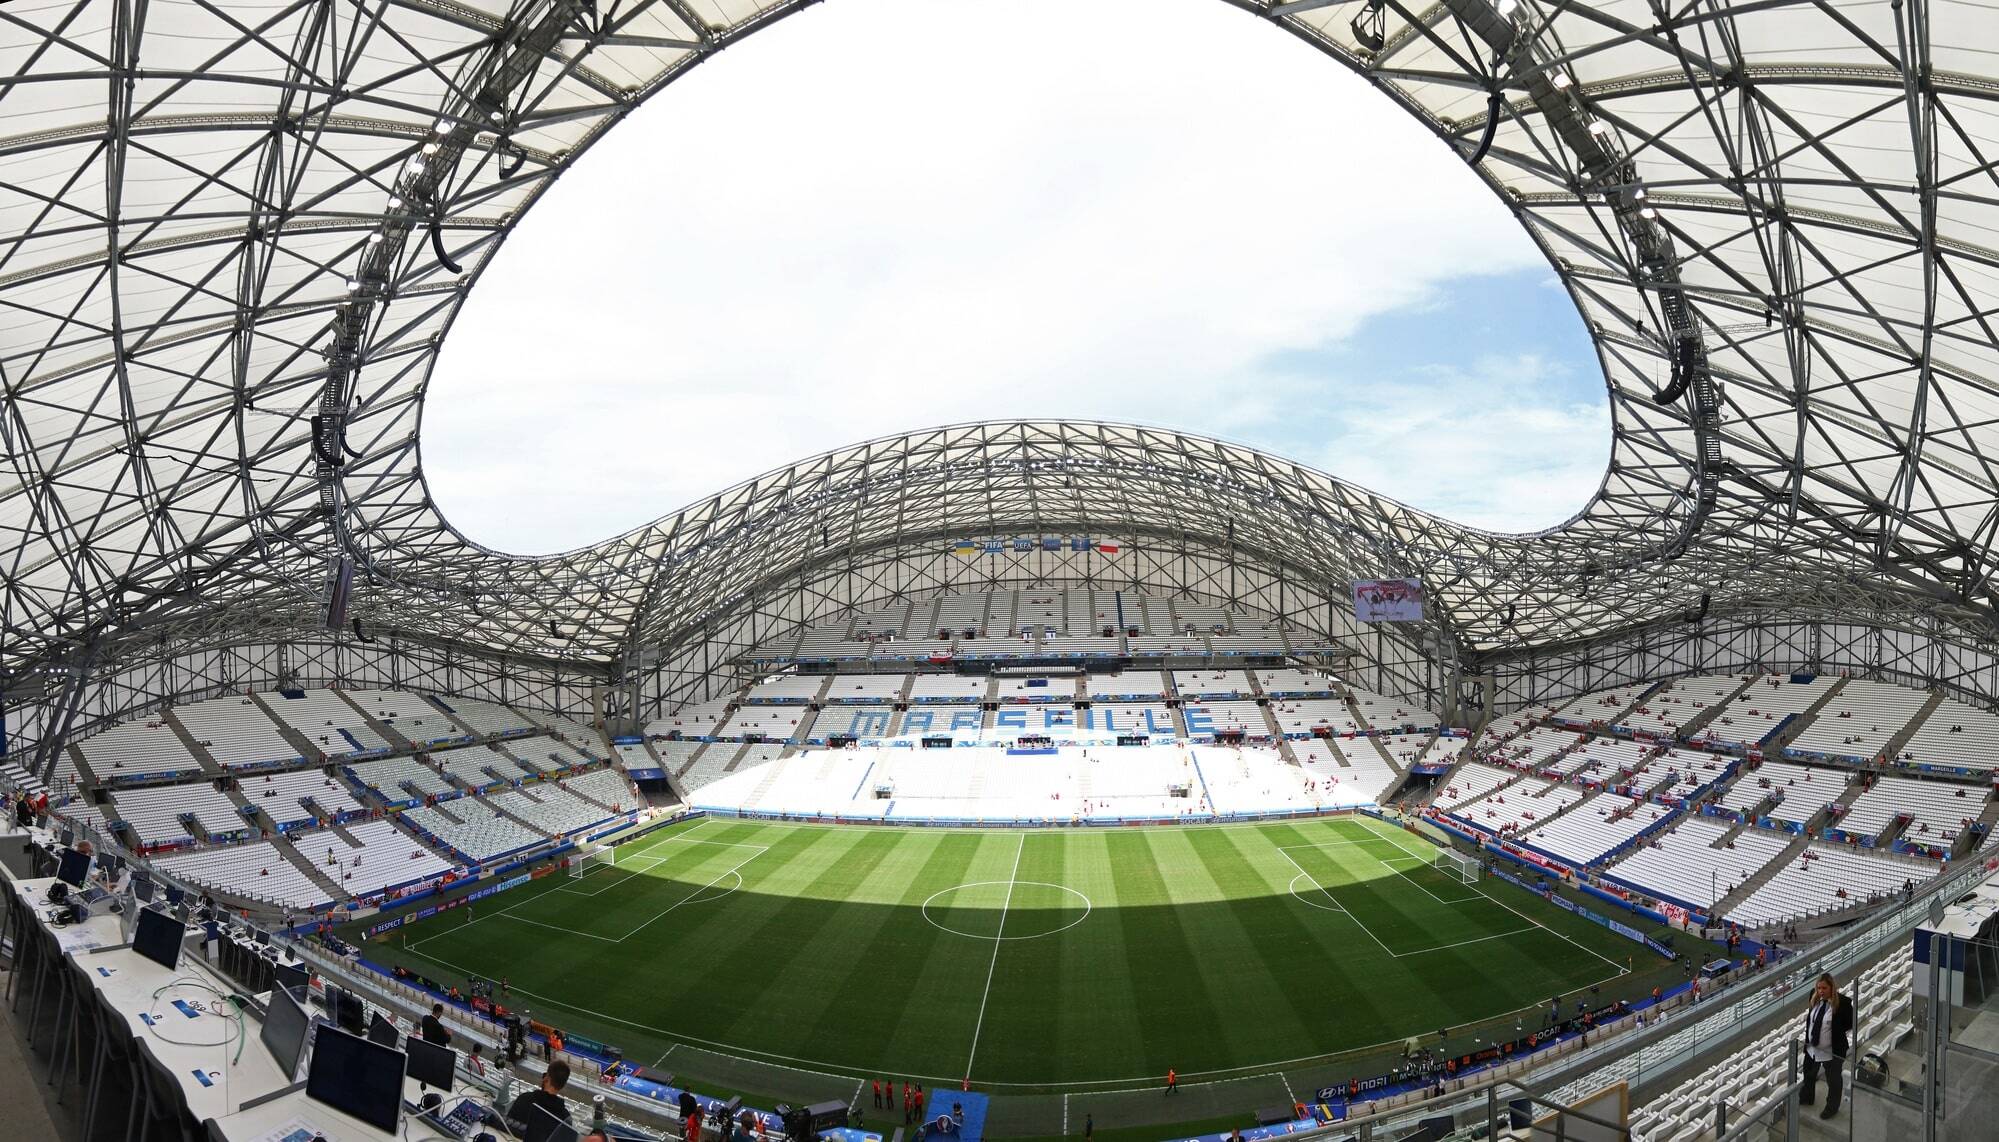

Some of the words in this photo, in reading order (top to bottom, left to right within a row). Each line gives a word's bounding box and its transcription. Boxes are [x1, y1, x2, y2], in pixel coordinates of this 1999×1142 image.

[985, 541, 1003, 549] FIFA
[848, 708, 1217, 737] MARSEILLE
[500, 875, 529, 889] Hisense
[378, 919, 400, 931] RESPECT
